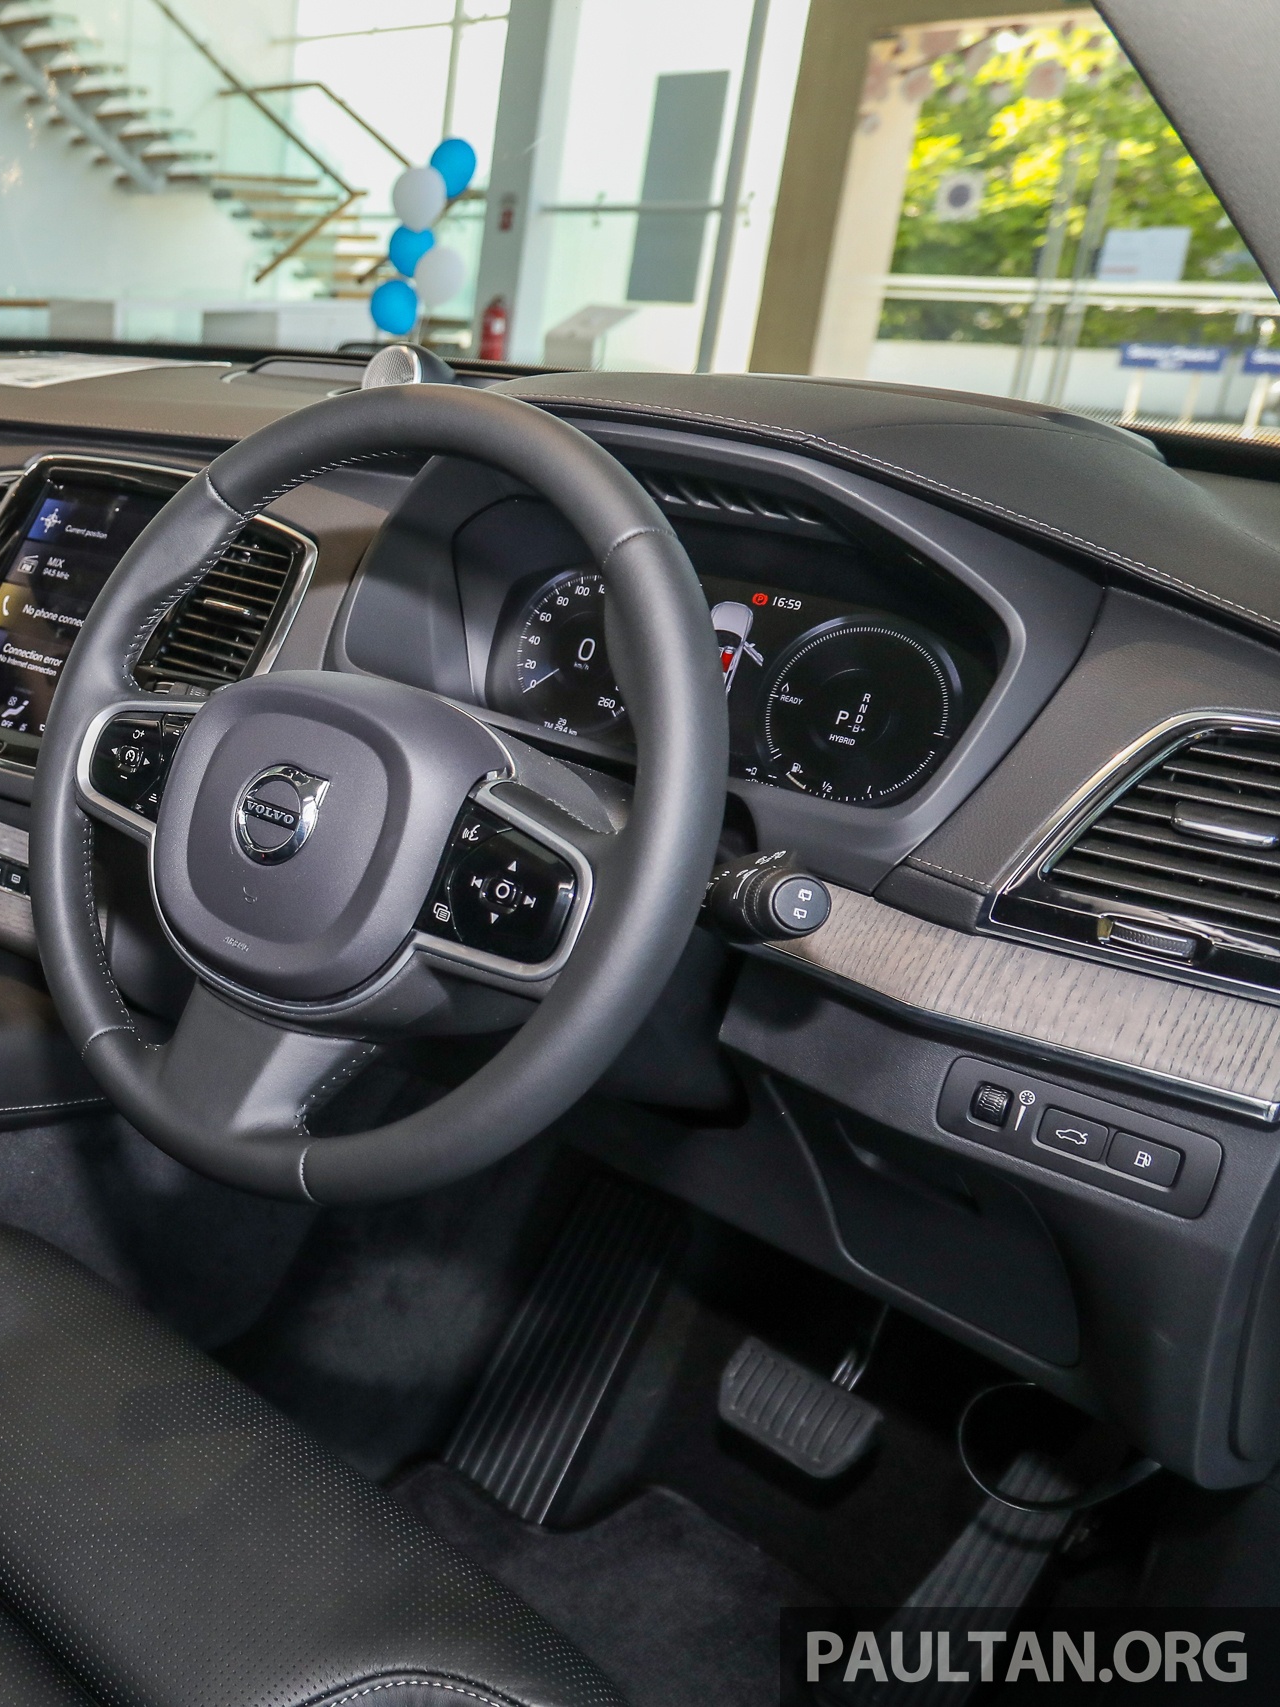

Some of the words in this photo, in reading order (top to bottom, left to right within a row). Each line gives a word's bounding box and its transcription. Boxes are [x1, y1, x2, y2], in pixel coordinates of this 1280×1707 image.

[65, 524, 86, 535] Current
[84, 529, 108, 540] position
[574, 585, 590, 597] 100
[556, 596, 570, 607] 80
[772, 596, 802, 611] 16:59
[23, 604, 35, 615] No
[32, 608, 59, 621] phone
[539, 612, 552, 623] 60
[528, 635, 541, 646] 40
[2, 643, 44, 663] Connection
[43, 655, 64, 668] error
[578, 638, 595, 661] 0
[27, 663, 58, 677] connection
[524, 659, 537, 670] 20
[597, 696, 616, 709] 260
[779, 694, 804, 706] READY
[862, 692, 872, 703] R
[858, 703, 869, 714] N
[835, 710, 850, 725] P
[855, 714, 864, 724] D
[568, 729, 578, 737] km
[829, 733, 856, 746] HYBRID
[246, 800, 294, 824] VOLVO
